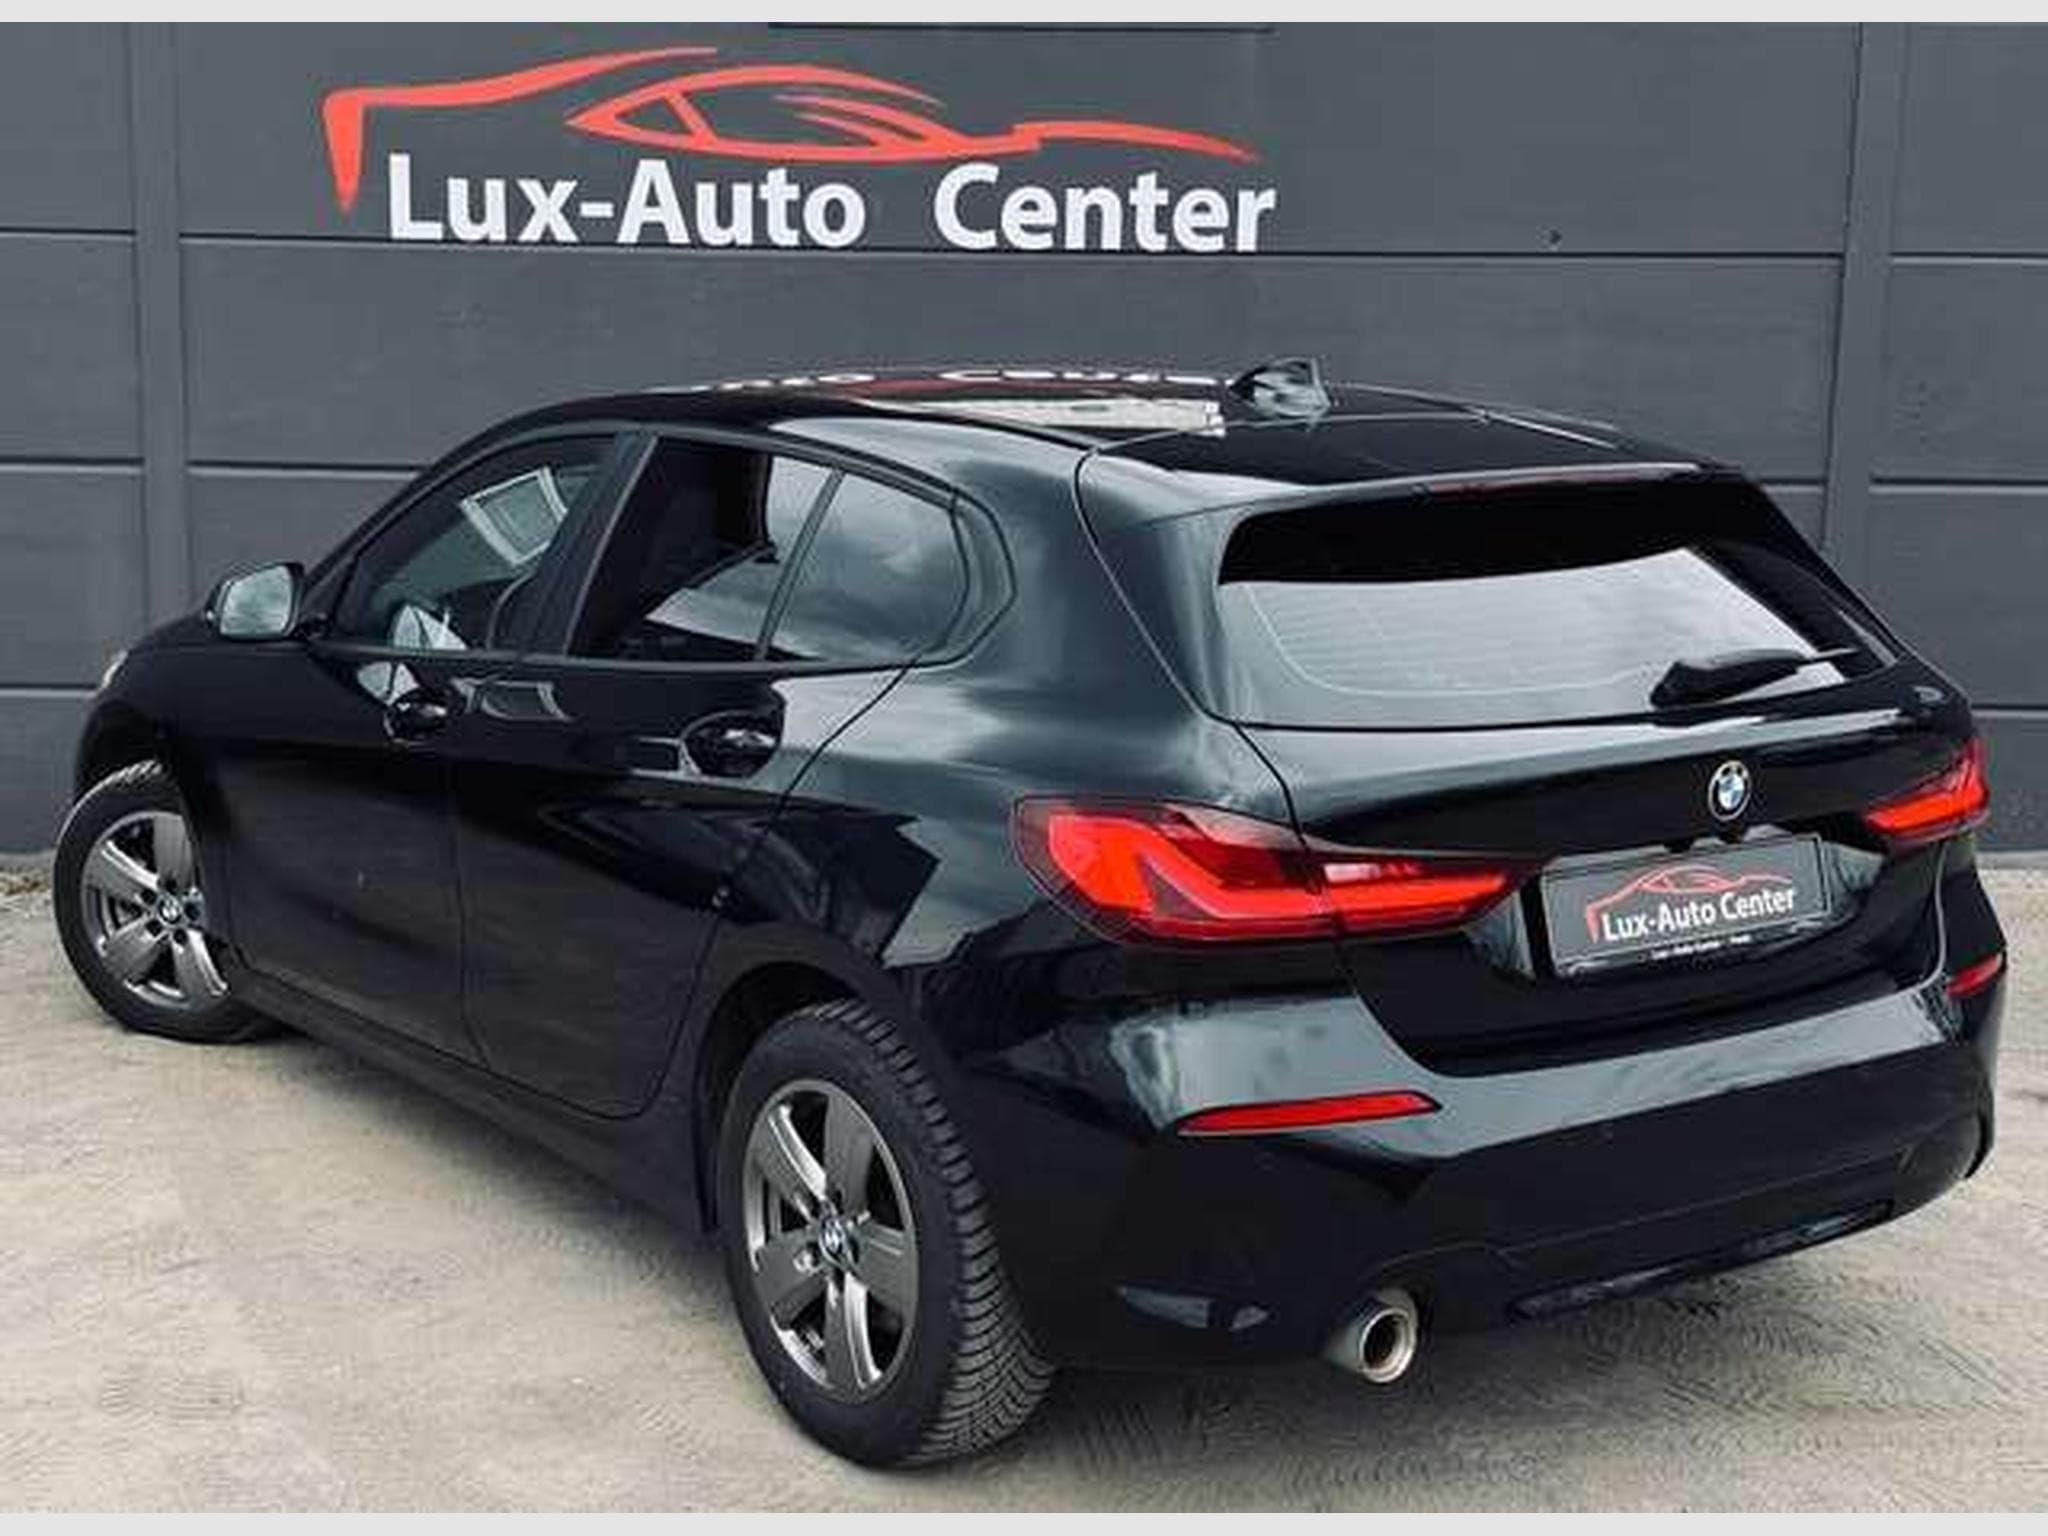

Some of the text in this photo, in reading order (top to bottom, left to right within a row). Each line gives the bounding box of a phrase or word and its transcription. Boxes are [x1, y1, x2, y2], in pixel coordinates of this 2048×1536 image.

[388, 153, 1276, 253] Lux-Auto Center
[1601, 887, 1797, 942] Lux-Auto Center
